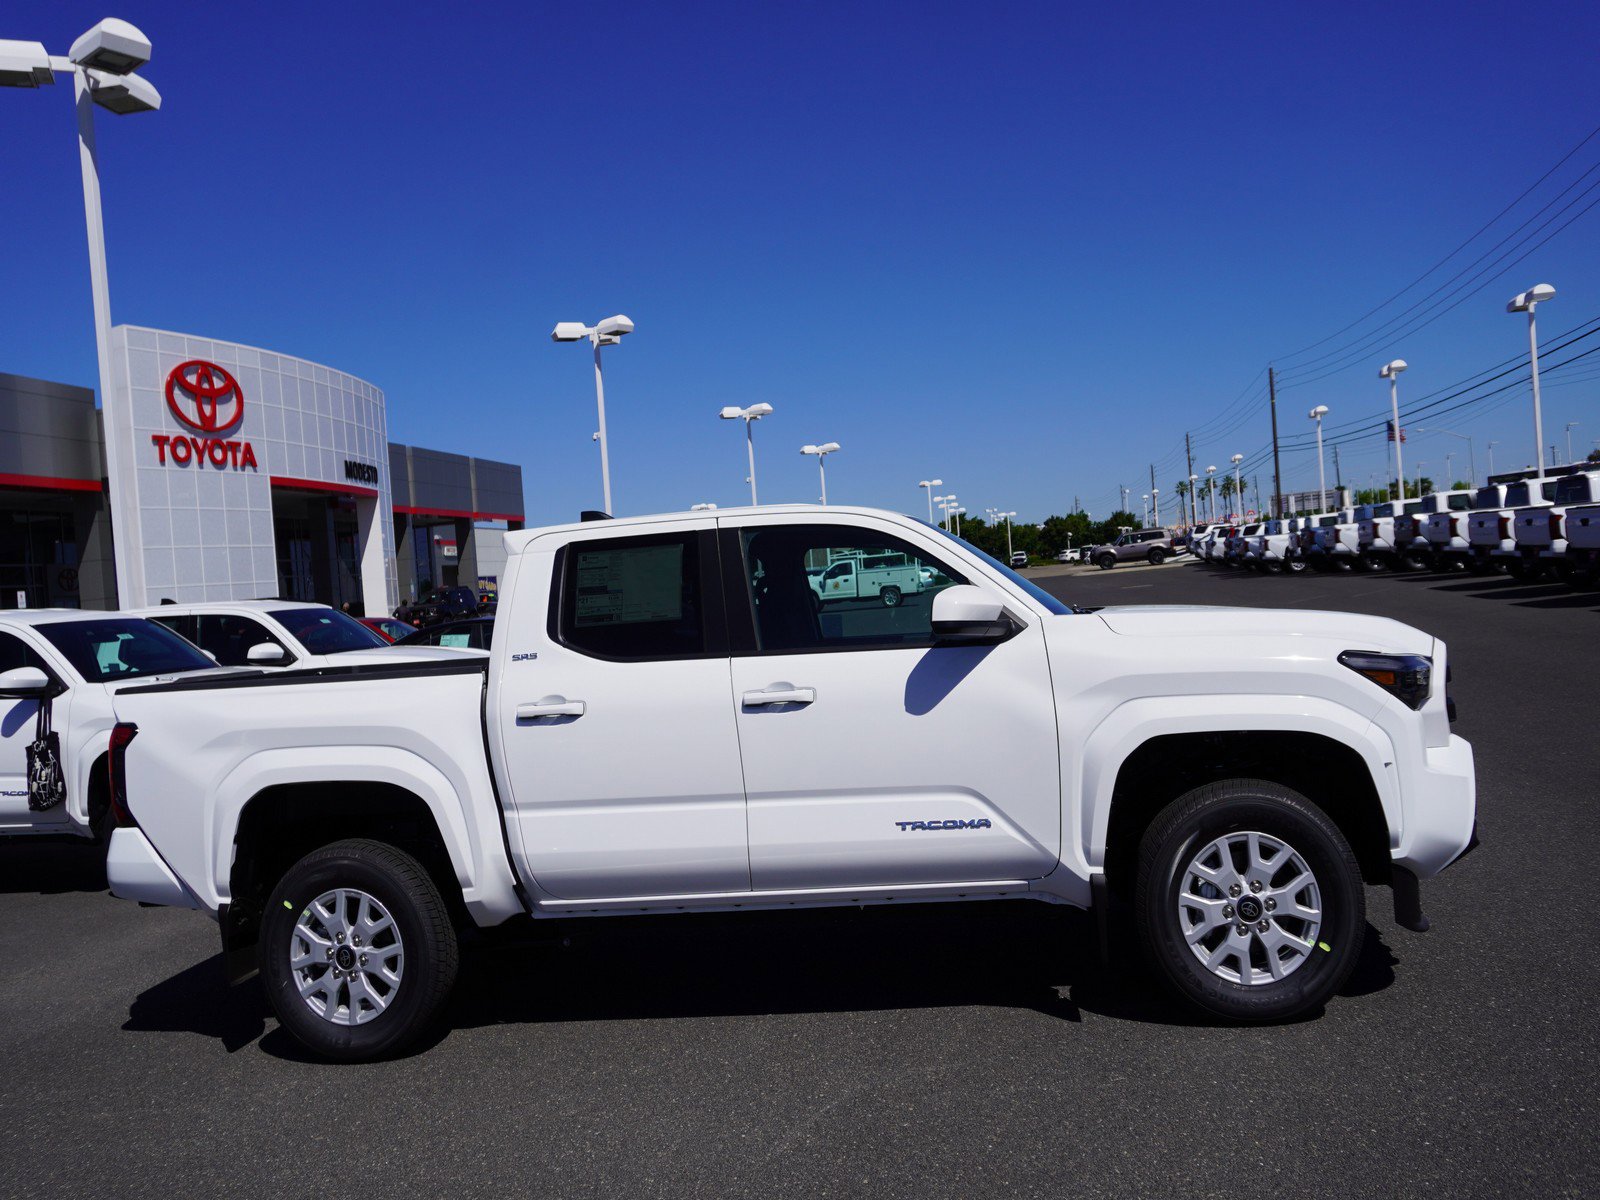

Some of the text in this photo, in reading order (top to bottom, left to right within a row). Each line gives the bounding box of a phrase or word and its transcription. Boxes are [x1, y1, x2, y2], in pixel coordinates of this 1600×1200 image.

[151, 434, 258, 469] TOYOTA
[344, 460, 379, 484] MODESTO
[895, 818, 992, 831] TACOMA
